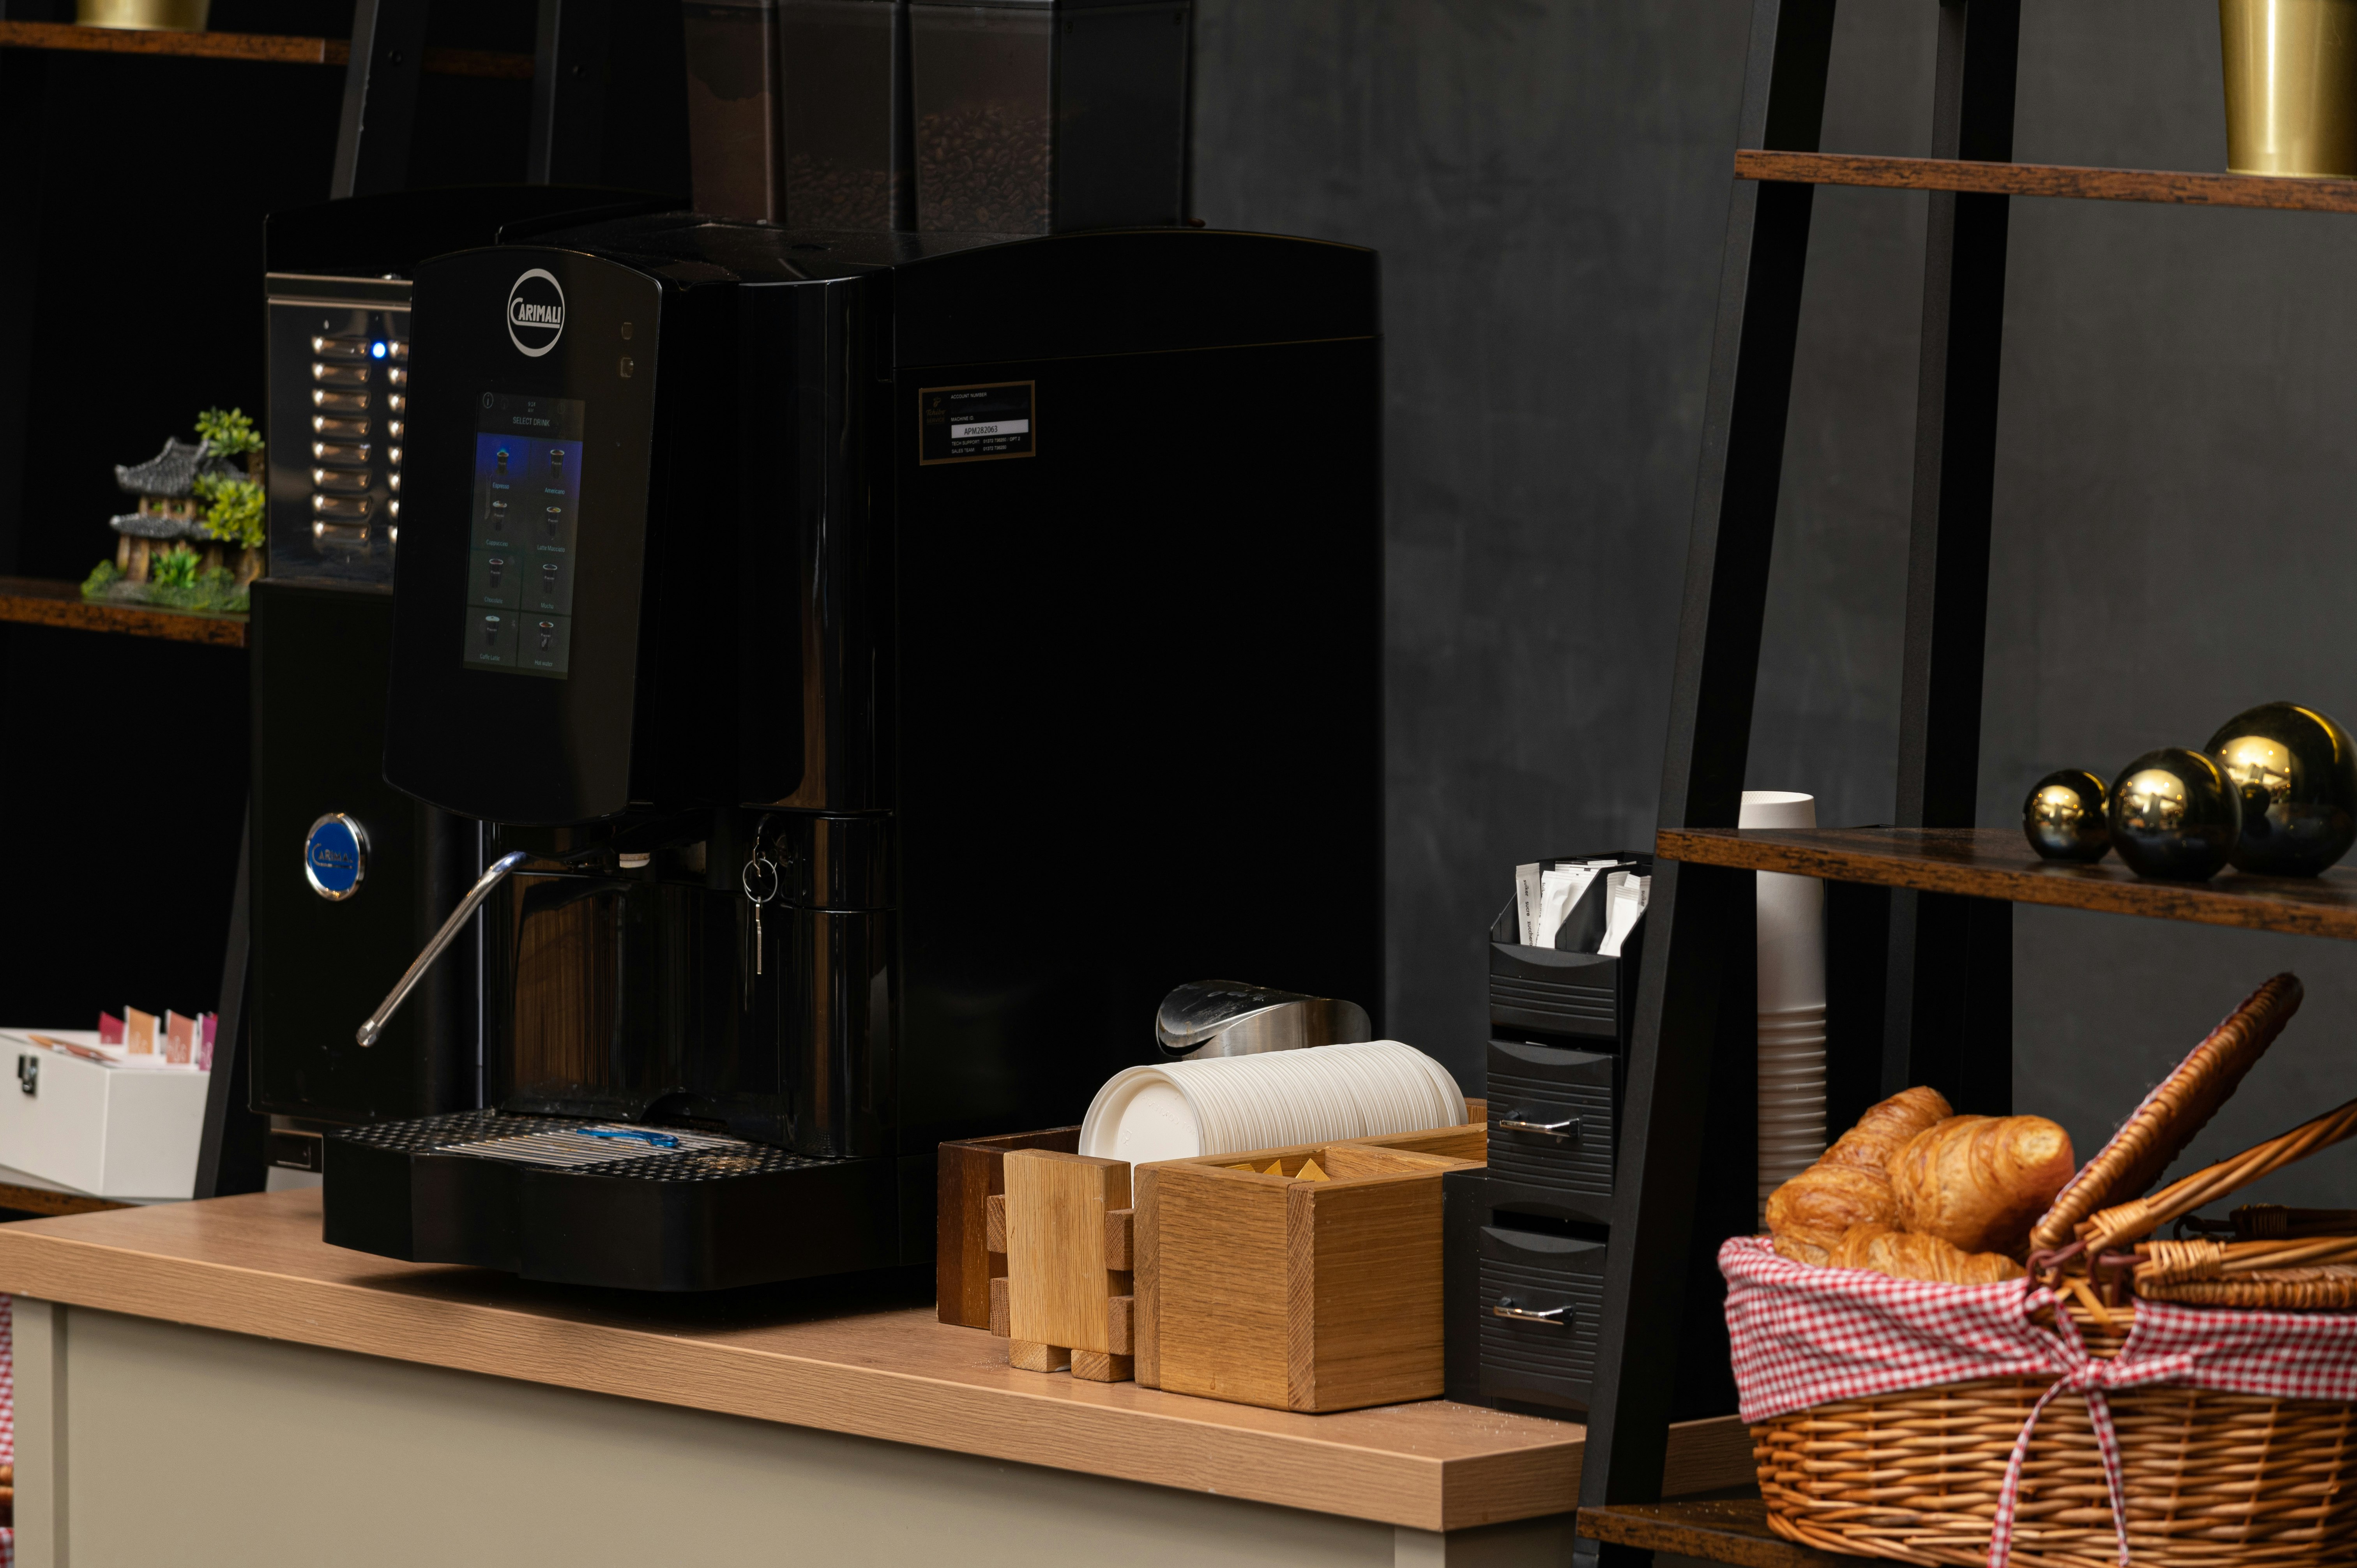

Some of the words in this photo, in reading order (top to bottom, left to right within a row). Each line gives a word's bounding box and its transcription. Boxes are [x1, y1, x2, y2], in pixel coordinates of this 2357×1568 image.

[510, 297, 561, 329] CARIMALI
[926, 409, 947, 417] Tchibo
[512, 416, 533, 425] SELECT
[533, 418, 550, 427] DRINK
[964, 425, 998, 435] APM282063
[486, 539, 508, 547] Cappuccino
